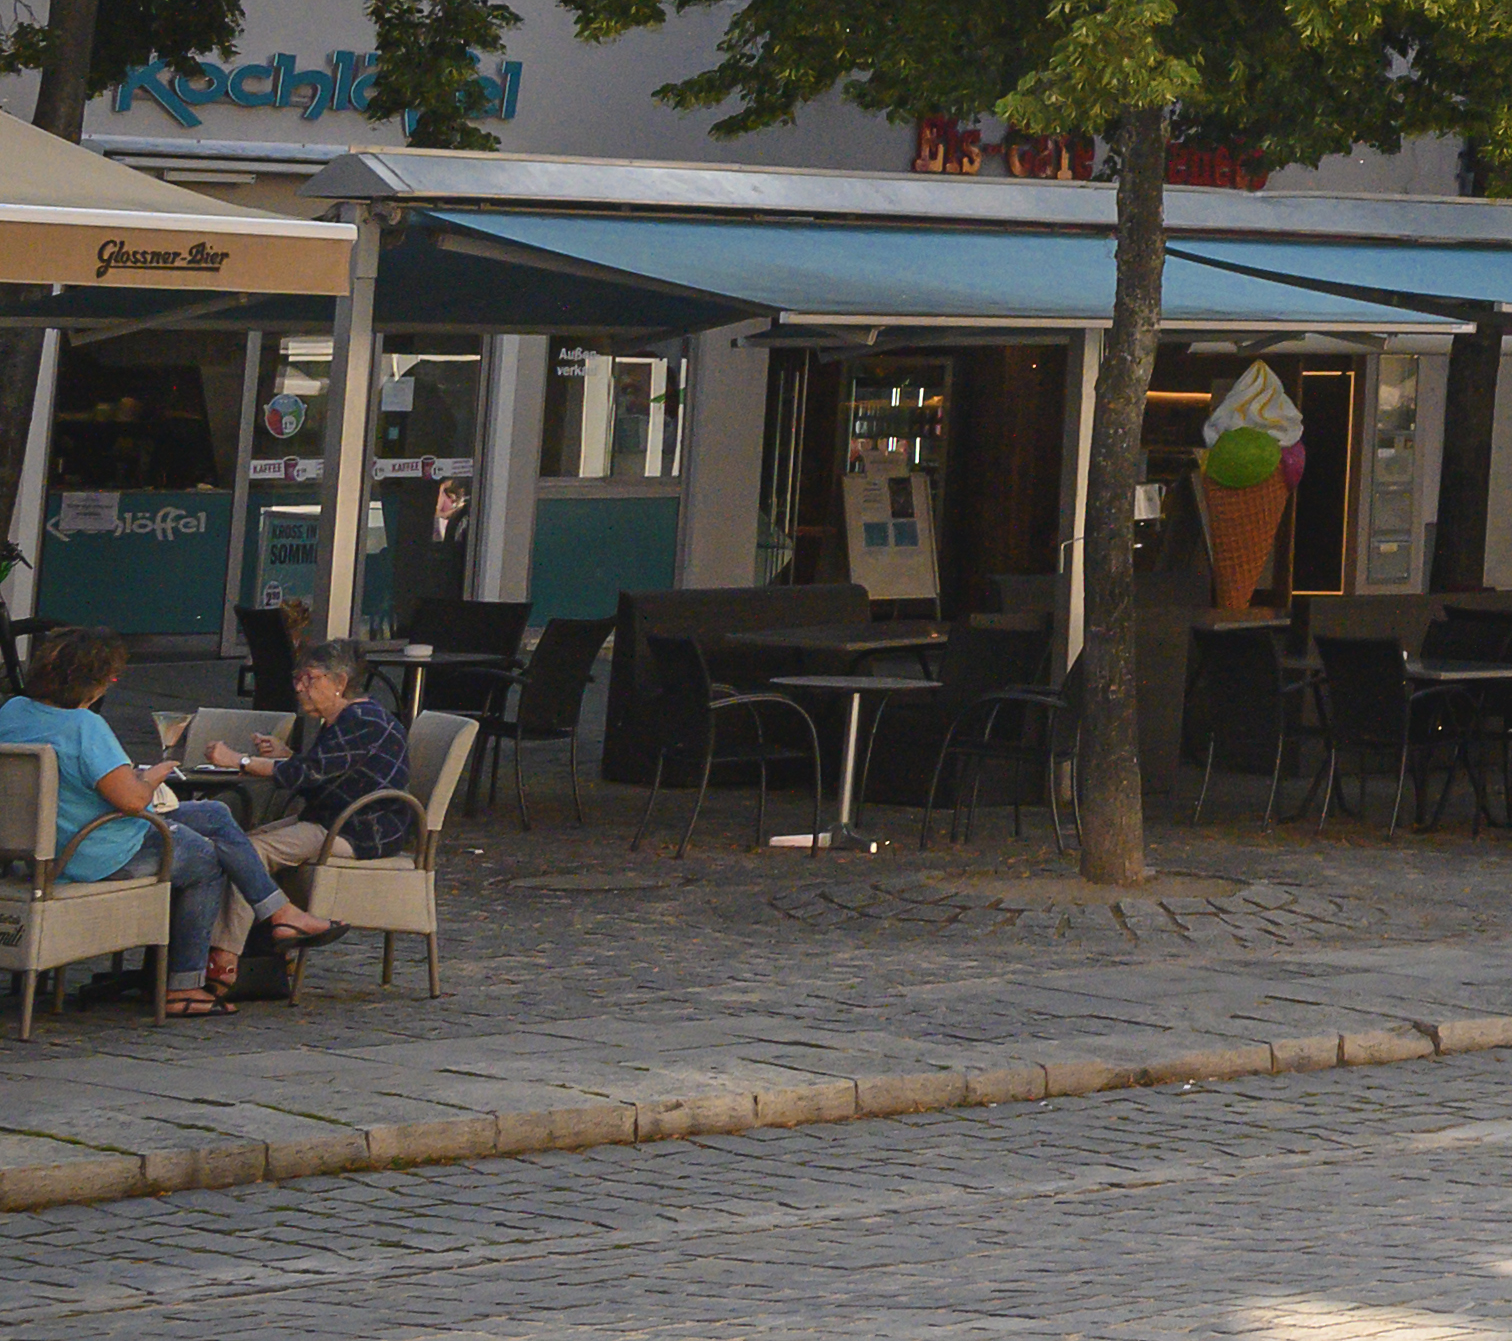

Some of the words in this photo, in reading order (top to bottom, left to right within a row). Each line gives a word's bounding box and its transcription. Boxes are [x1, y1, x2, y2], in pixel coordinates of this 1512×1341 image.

[96, 239, 229, 278] Glossner-Bier
[253, 462, 282, 474] KAFFEE
[392, 462, 419, 473] KAFFEE
